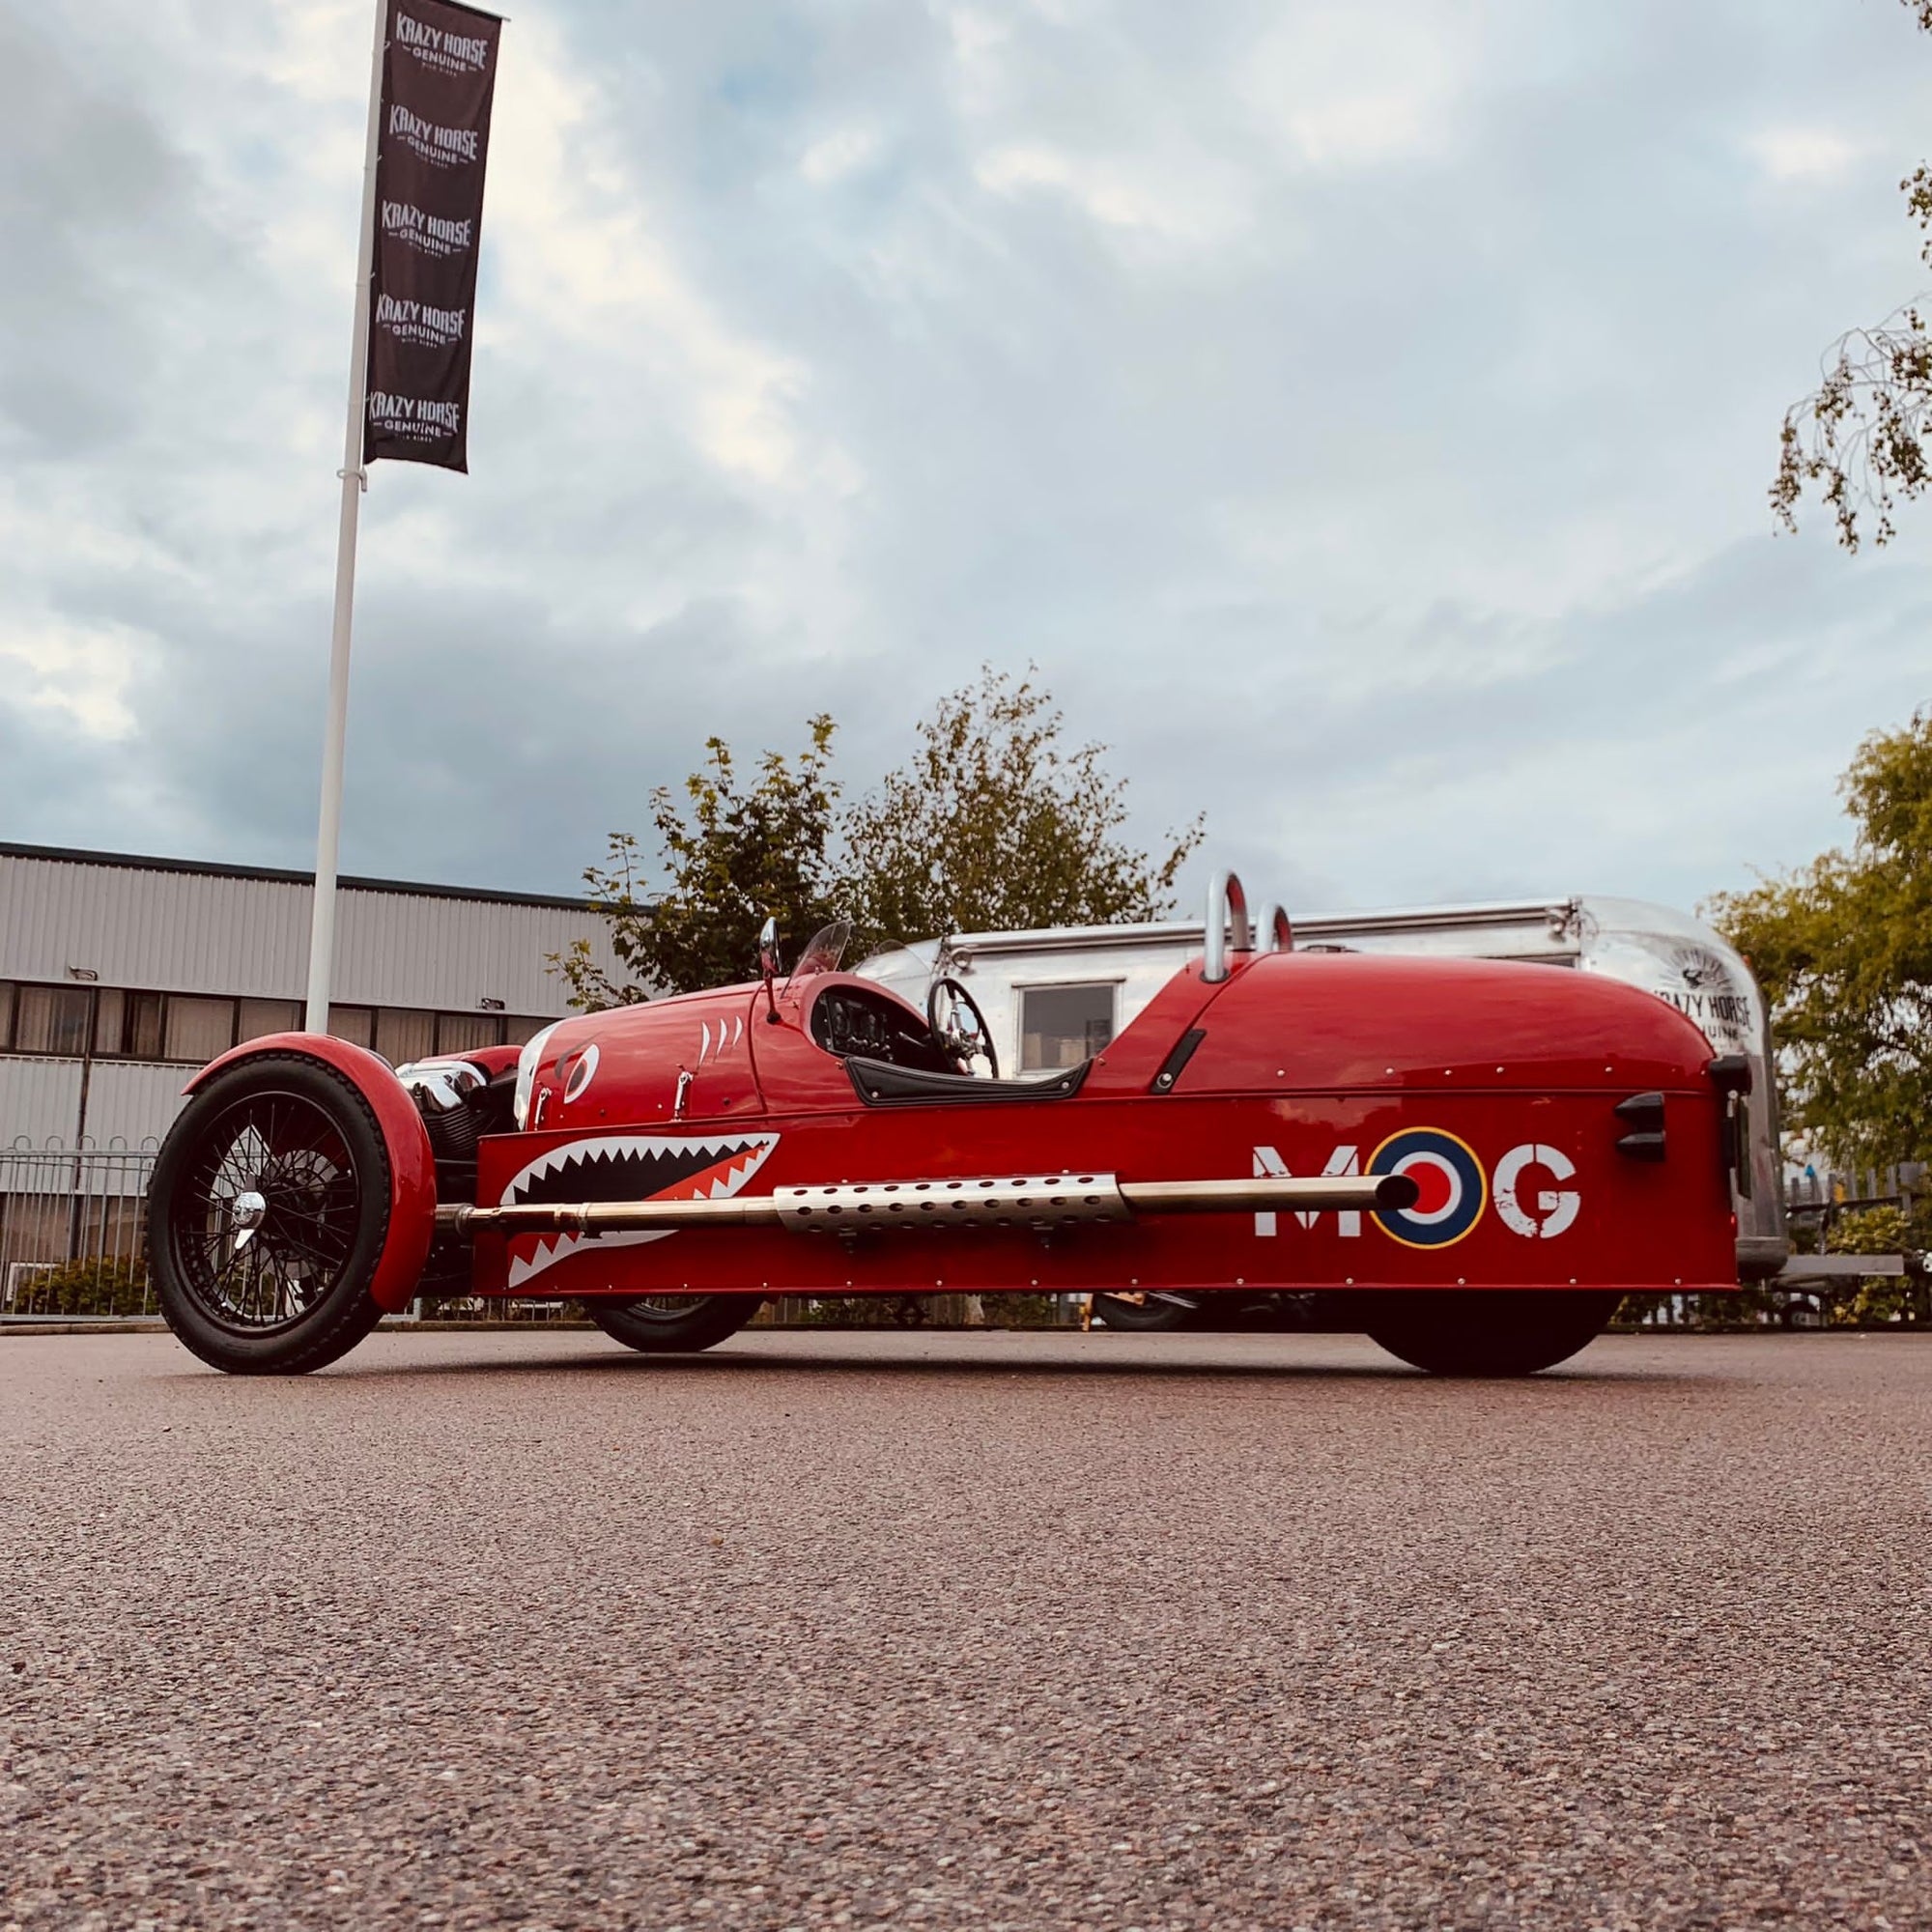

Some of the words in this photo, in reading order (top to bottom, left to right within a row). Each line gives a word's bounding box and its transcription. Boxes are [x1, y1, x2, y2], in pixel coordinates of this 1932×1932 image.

[396, 12, 441, 49] KRAZY
[443, 32, 488, 70] HORSE
[412, 47, 467, 72] GENUINE
[389, 104, 433, 138] KRAZY
[435, 126, 478, 160] HORSE
[407, 136, 458, 164] GENUINE
[383, 200, 425, 230] KRAZY
[428, 213, 471, 247] HORSE
[400, 229, 451, 255] GENUINE
[376, 294, 419, 324] KRAZY
[422, 305, 466, 339] HORSE
[392, 325, 446, 345] GENUINE
[369, 391, 414, 421] KRAZY
[417, 398, 460, 434] HORSE
[384, 420, 441, 438] GENUINE
[1709, 995, 1753, 1033] HORSE
